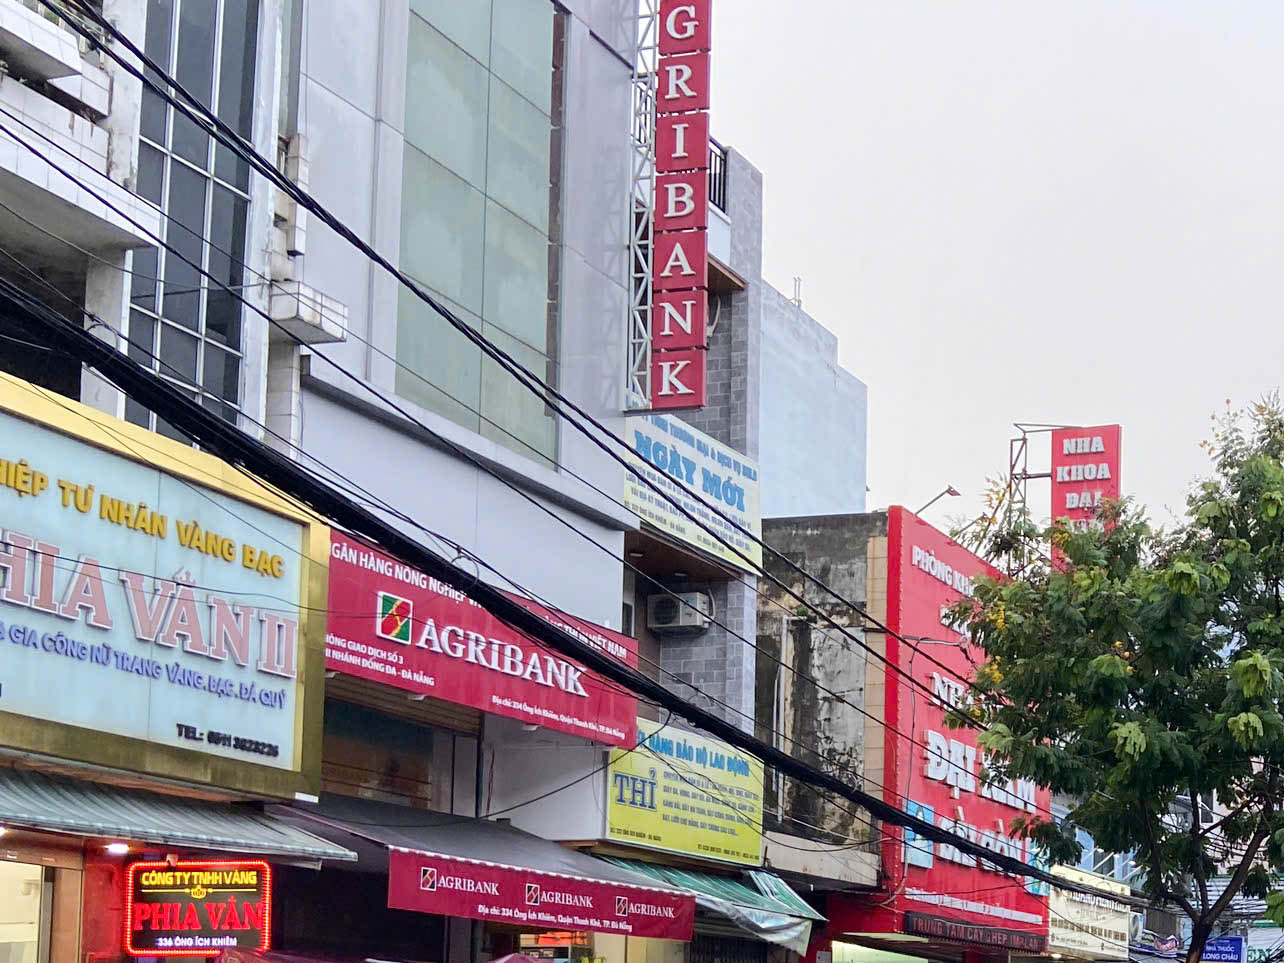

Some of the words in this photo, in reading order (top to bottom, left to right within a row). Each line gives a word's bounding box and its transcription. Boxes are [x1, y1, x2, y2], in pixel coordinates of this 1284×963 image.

[1063, 436, 1104, 455] NHA
[634, 430, 696, 485] NGÀY
[702, 467, 745, 513] MỚI
[1056, 463, 1111, 483] KHOA
[58, 479, 96, 513] TƯ
[100, 493, 168, 539] NHÂN
[176, 519, 237, 562] VÀNG
[242, 543, 285, 578] BẠC
[359, 550, 393, 577] HÀNG
[394, 563, 428, 591] NÔNG
[911, 545, 952, 586] PHÒNG
[118, 565, 255, 667] VÂN
[257, 609, 298, 679] II
[332, 650, 361, 665] NHÁNH
[347, 640, 367, 654] GIAO
[368, 646, 387, 660] DỊCH
[415, 617, 590, 698] AGRIBANK
[9, 625, 39, 649] GIA
[42, 631, 88, 661] CÔNG
[90, 643, 112, 666] NỮ
[114, 652, 162, 680] TRANG
[259, 687, 287, 710] QUÝ
[141, 870, 173, 885] CÔNG
[176, 871, 190, 885] TY
[192, 871, 222, 885] TNHH
[223, 869, 257, 885] VÀNG
[437, 874, 500, 896] AGRIBANK
[540, 890, 594, 909] AGRIBANK
[133, 902, 202, 931] PHIA
[205, 895, 264, 931] VÂN
[478, 904, 489, 915] Địa
[514, 907, 527, 920] Ông
[528, 909, 537, 920] Ích
[628, 902, 675, 919] AGRIBANK
[174, 935, 193, 947] ÔNG
[195, 935, 210, 947] ÍCH
[212, 935, 237, 947] KHIÊM
[1221, 952, 1238, 960] CHÂU
